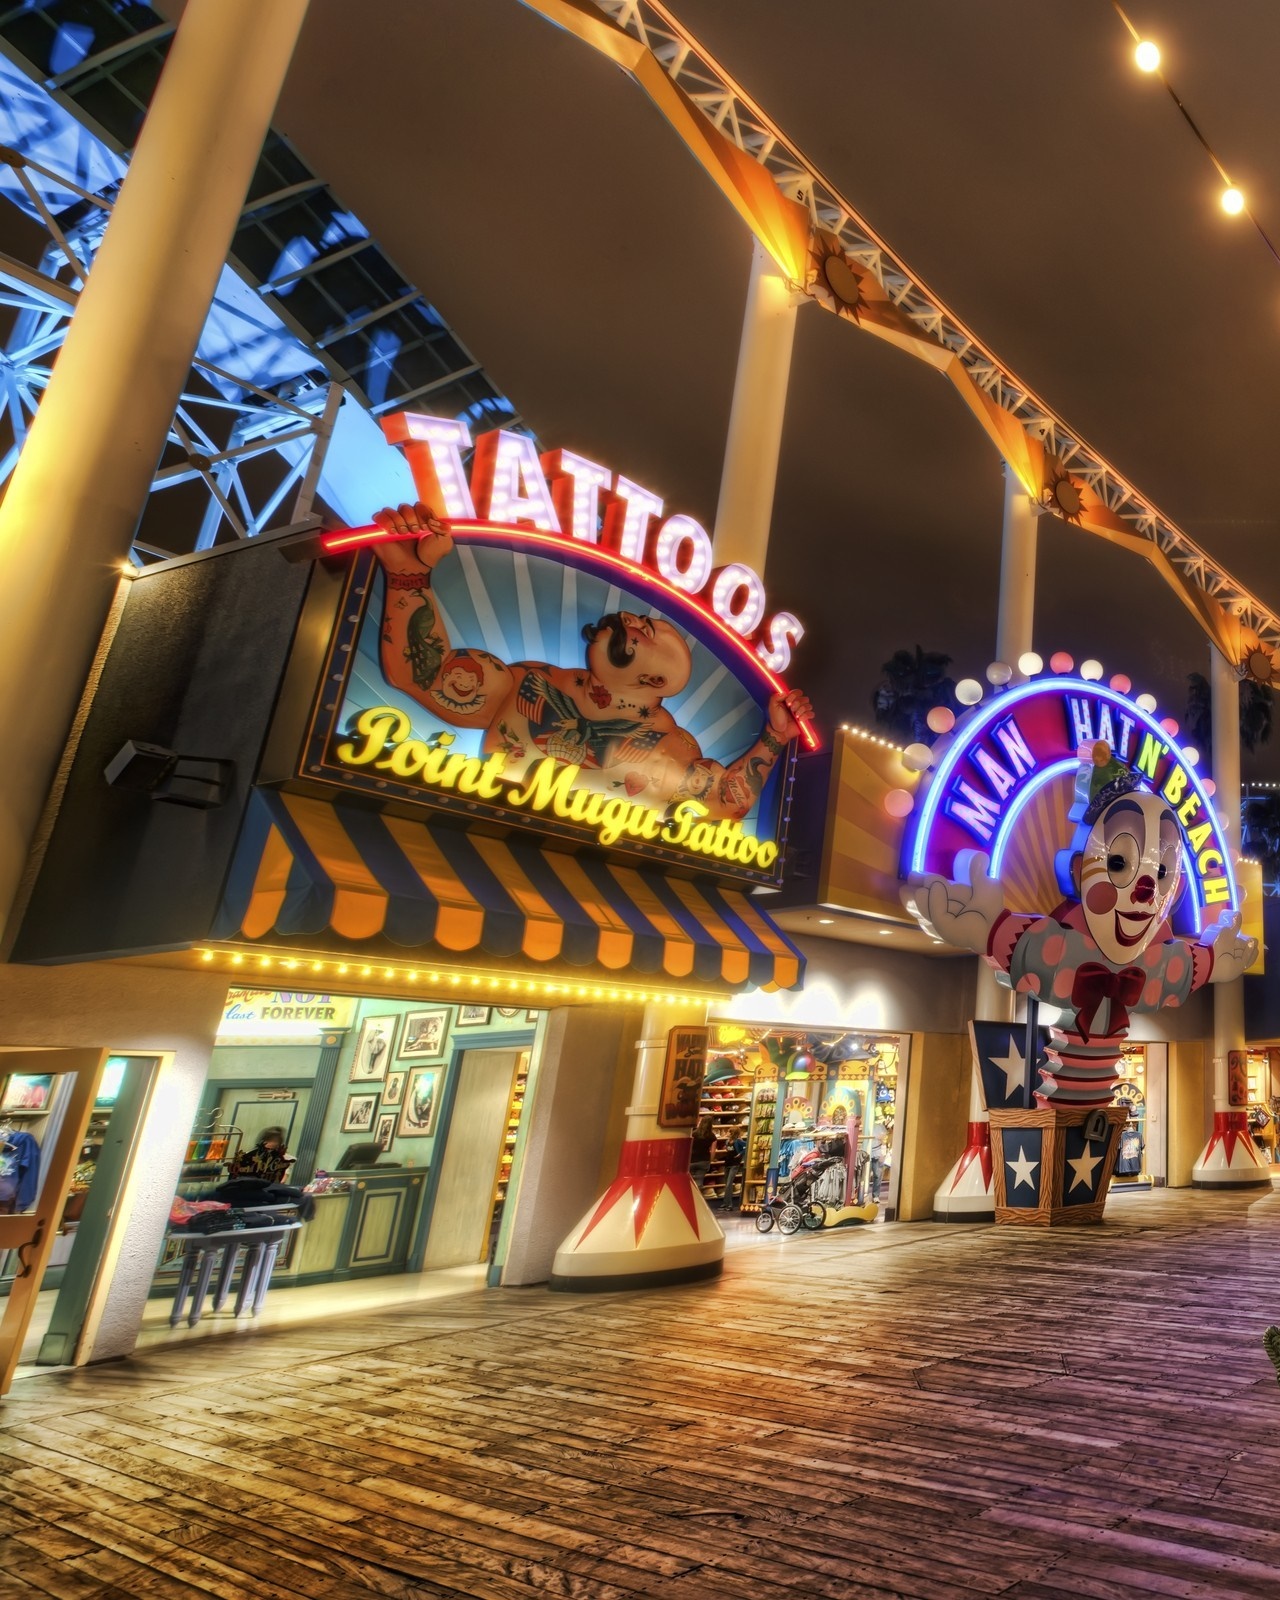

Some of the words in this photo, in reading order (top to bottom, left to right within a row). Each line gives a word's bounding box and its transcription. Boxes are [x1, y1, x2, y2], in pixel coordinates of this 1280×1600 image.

[395, 411, 805, 674] TATTOOS
[337, 705, 507, 799] Point
[507, 757, 664, 847] Mugu
[660, 798, 780, 869] Tattoo
[947, 715, 1038, 843] MAN
[1068, 697, 1136, 759] HAT
[1163, 761, 1230, 906] BEACH
[225, 1004, 255, 1020] last
[260, 1007, 336, 1020] FOREVER
